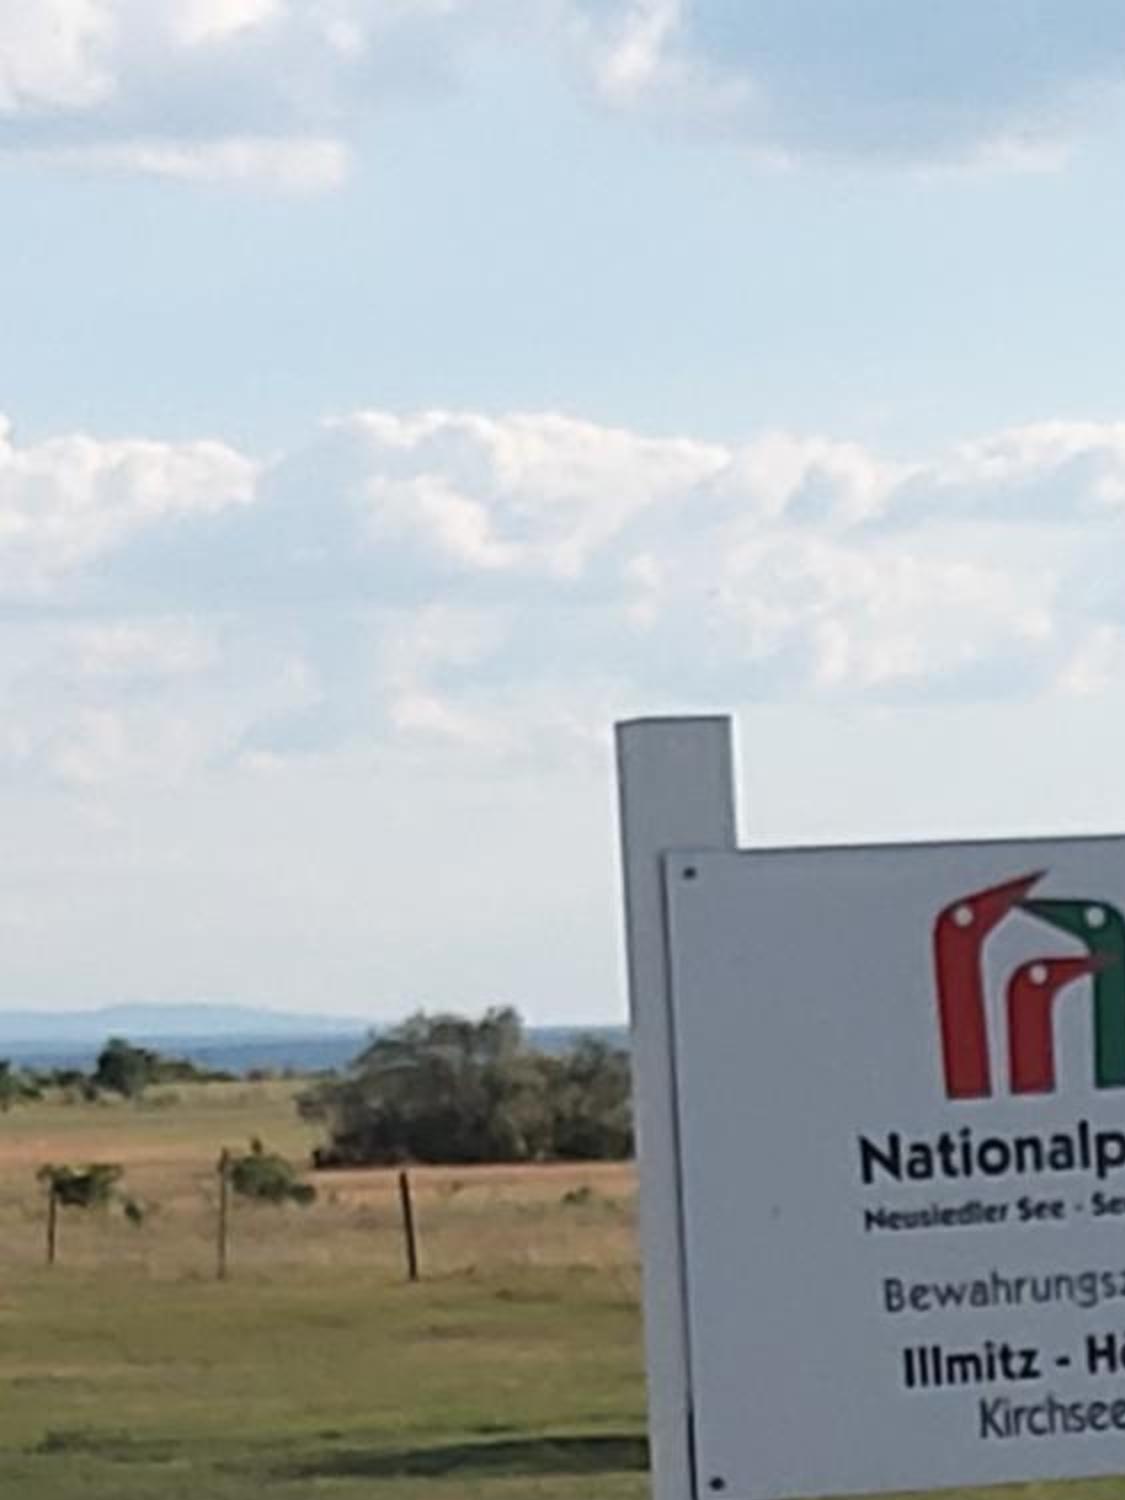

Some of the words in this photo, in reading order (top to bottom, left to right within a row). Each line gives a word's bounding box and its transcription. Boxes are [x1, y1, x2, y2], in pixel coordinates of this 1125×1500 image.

[865, 1199, 1008, 1232] Neusiedler
[1017, 1196, 1065, 1221] See
[904, 1341, 1041, 1388] Illmitz
